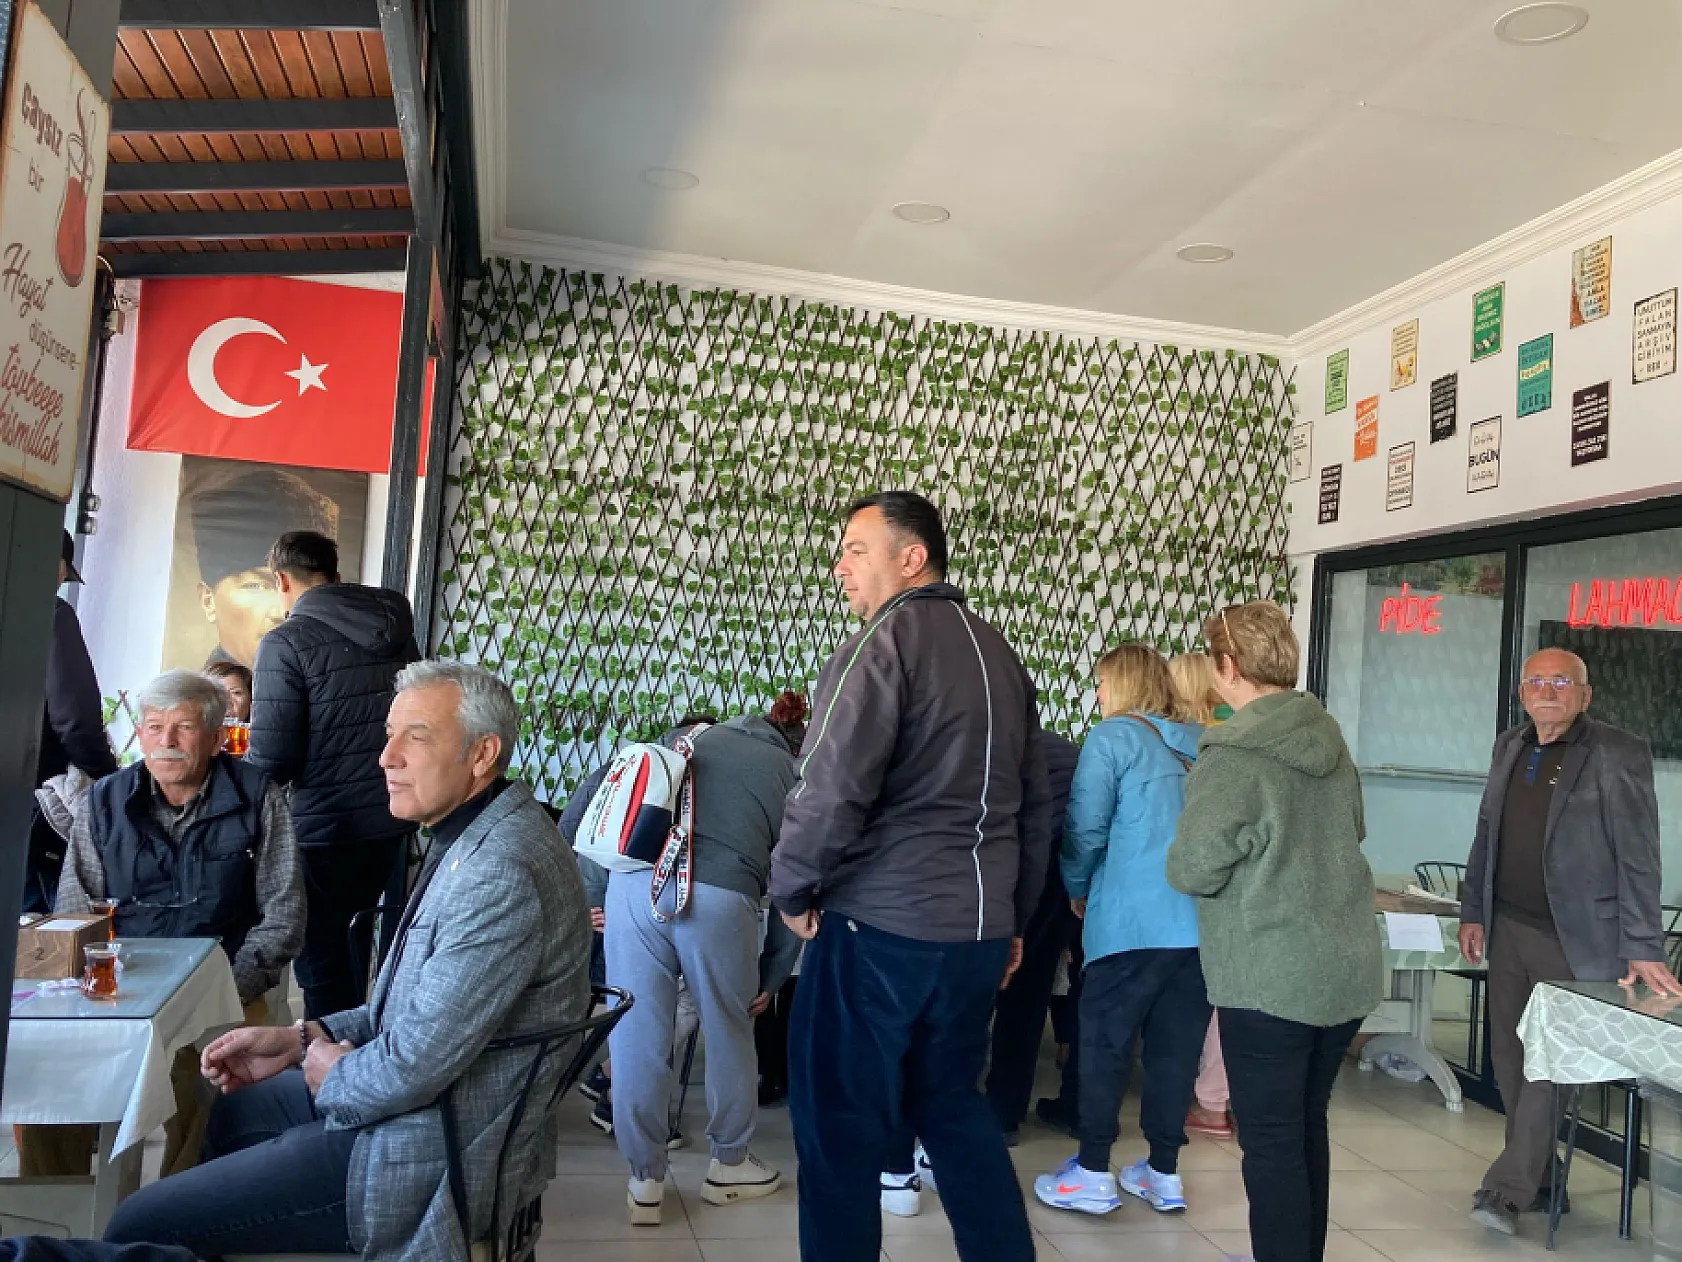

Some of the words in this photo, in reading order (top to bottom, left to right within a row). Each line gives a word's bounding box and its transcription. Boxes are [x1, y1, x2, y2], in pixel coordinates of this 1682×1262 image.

[28, 157, 45, 193] bir
[2, 242, 54, 319] Hayat
[1379, 582, 1443, 635] PİDE
[35, 947, 45, 961] 2
